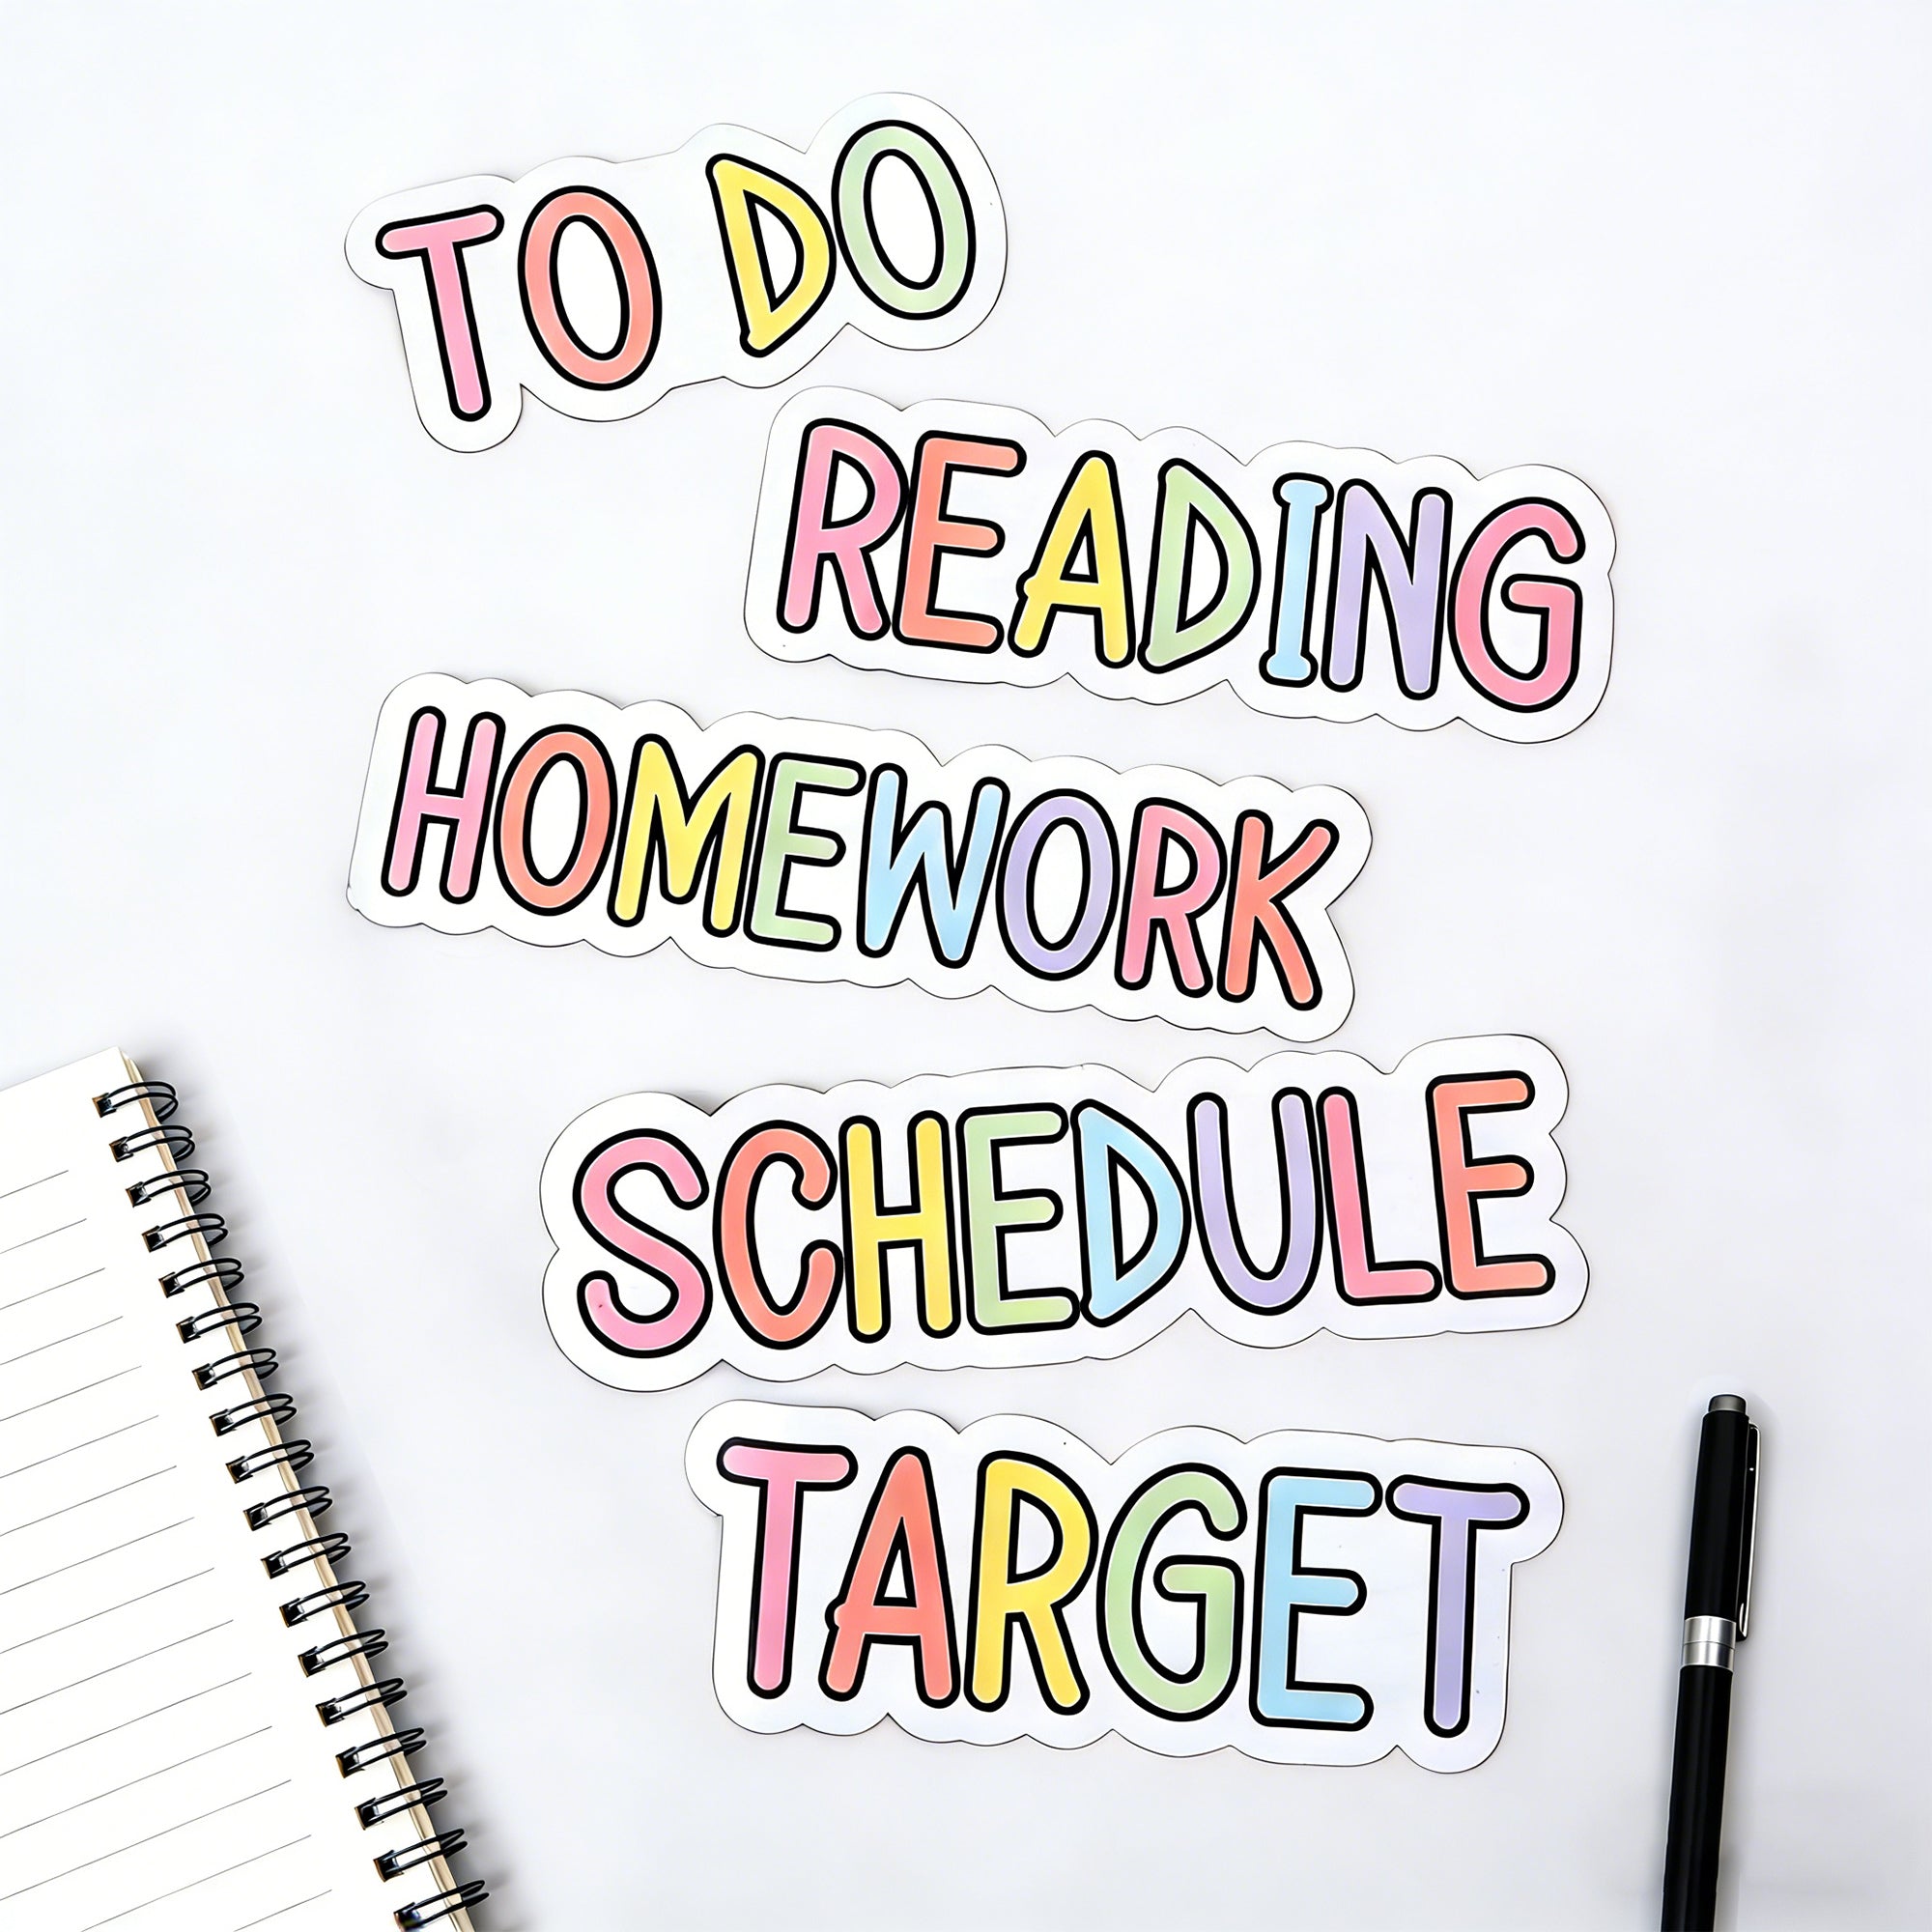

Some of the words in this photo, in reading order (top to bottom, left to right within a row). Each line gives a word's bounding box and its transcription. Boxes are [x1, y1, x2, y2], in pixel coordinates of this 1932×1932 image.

[375, 185, 663, 422] TO
[705, 119, 977, 358] DO
[776, 417, 1586, 714] READING
[381, 705, 1340, 1011] HOMEWORK
[572, 1069, 1556, 1359] SCHEDULE
[716, 1436, 1531, 1739] TARGET
